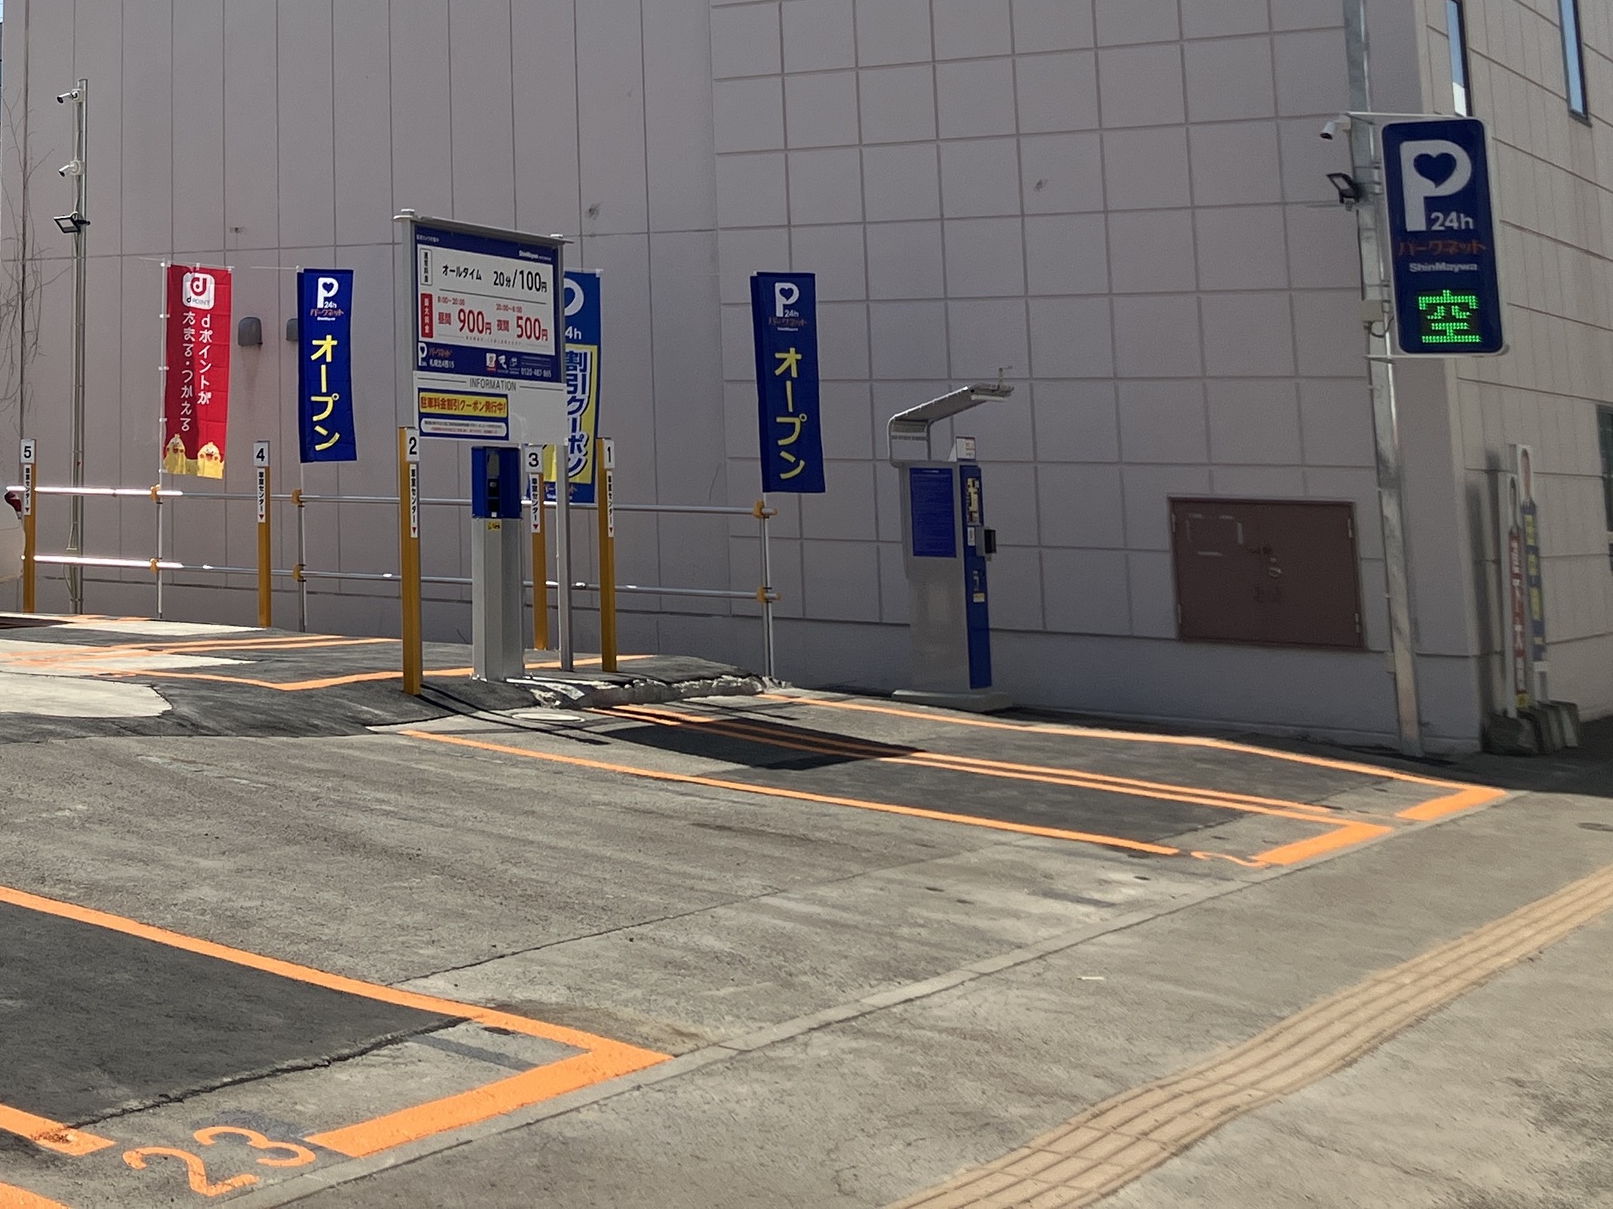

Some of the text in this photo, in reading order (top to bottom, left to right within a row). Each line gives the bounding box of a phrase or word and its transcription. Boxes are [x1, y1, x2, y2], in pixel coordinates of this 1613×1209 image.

[1399, 139, 1472, 232] P
[1430, 211, 1474, 230] 24h
[442, 264, 482, 281] オールタイム
[1409, 261, 1478, 273] ShinMaywa
[317, 277, 339, 308] P
[774, 282, 800, 317] P
[324, 301, 338, 309] 24h
[784, 309, 799, 318] 24h
[458, 308, 492, 335] 900円
[1418, 289, 1482, 343] 空
[516, 315, 548, 341] 500円
[565, 325, 582, 341] 4h
[197, 314, 213, 405] dポイントが
[179, 311, 196, 432] たまる・つかえる
[310, 334, 340, 452] オープン
[469, 377, 517, 391] INFORMATION
[774, 347, 808, 480] オープン
[23, 446, 32, 458] 5
[256, 447, 265, 461] 4
[409, 436, 417, 455] 2
[607, 446, 612, 463] 1
[528, 452, 539, 467] 3
[121, 1125, 317, 1197] 23
